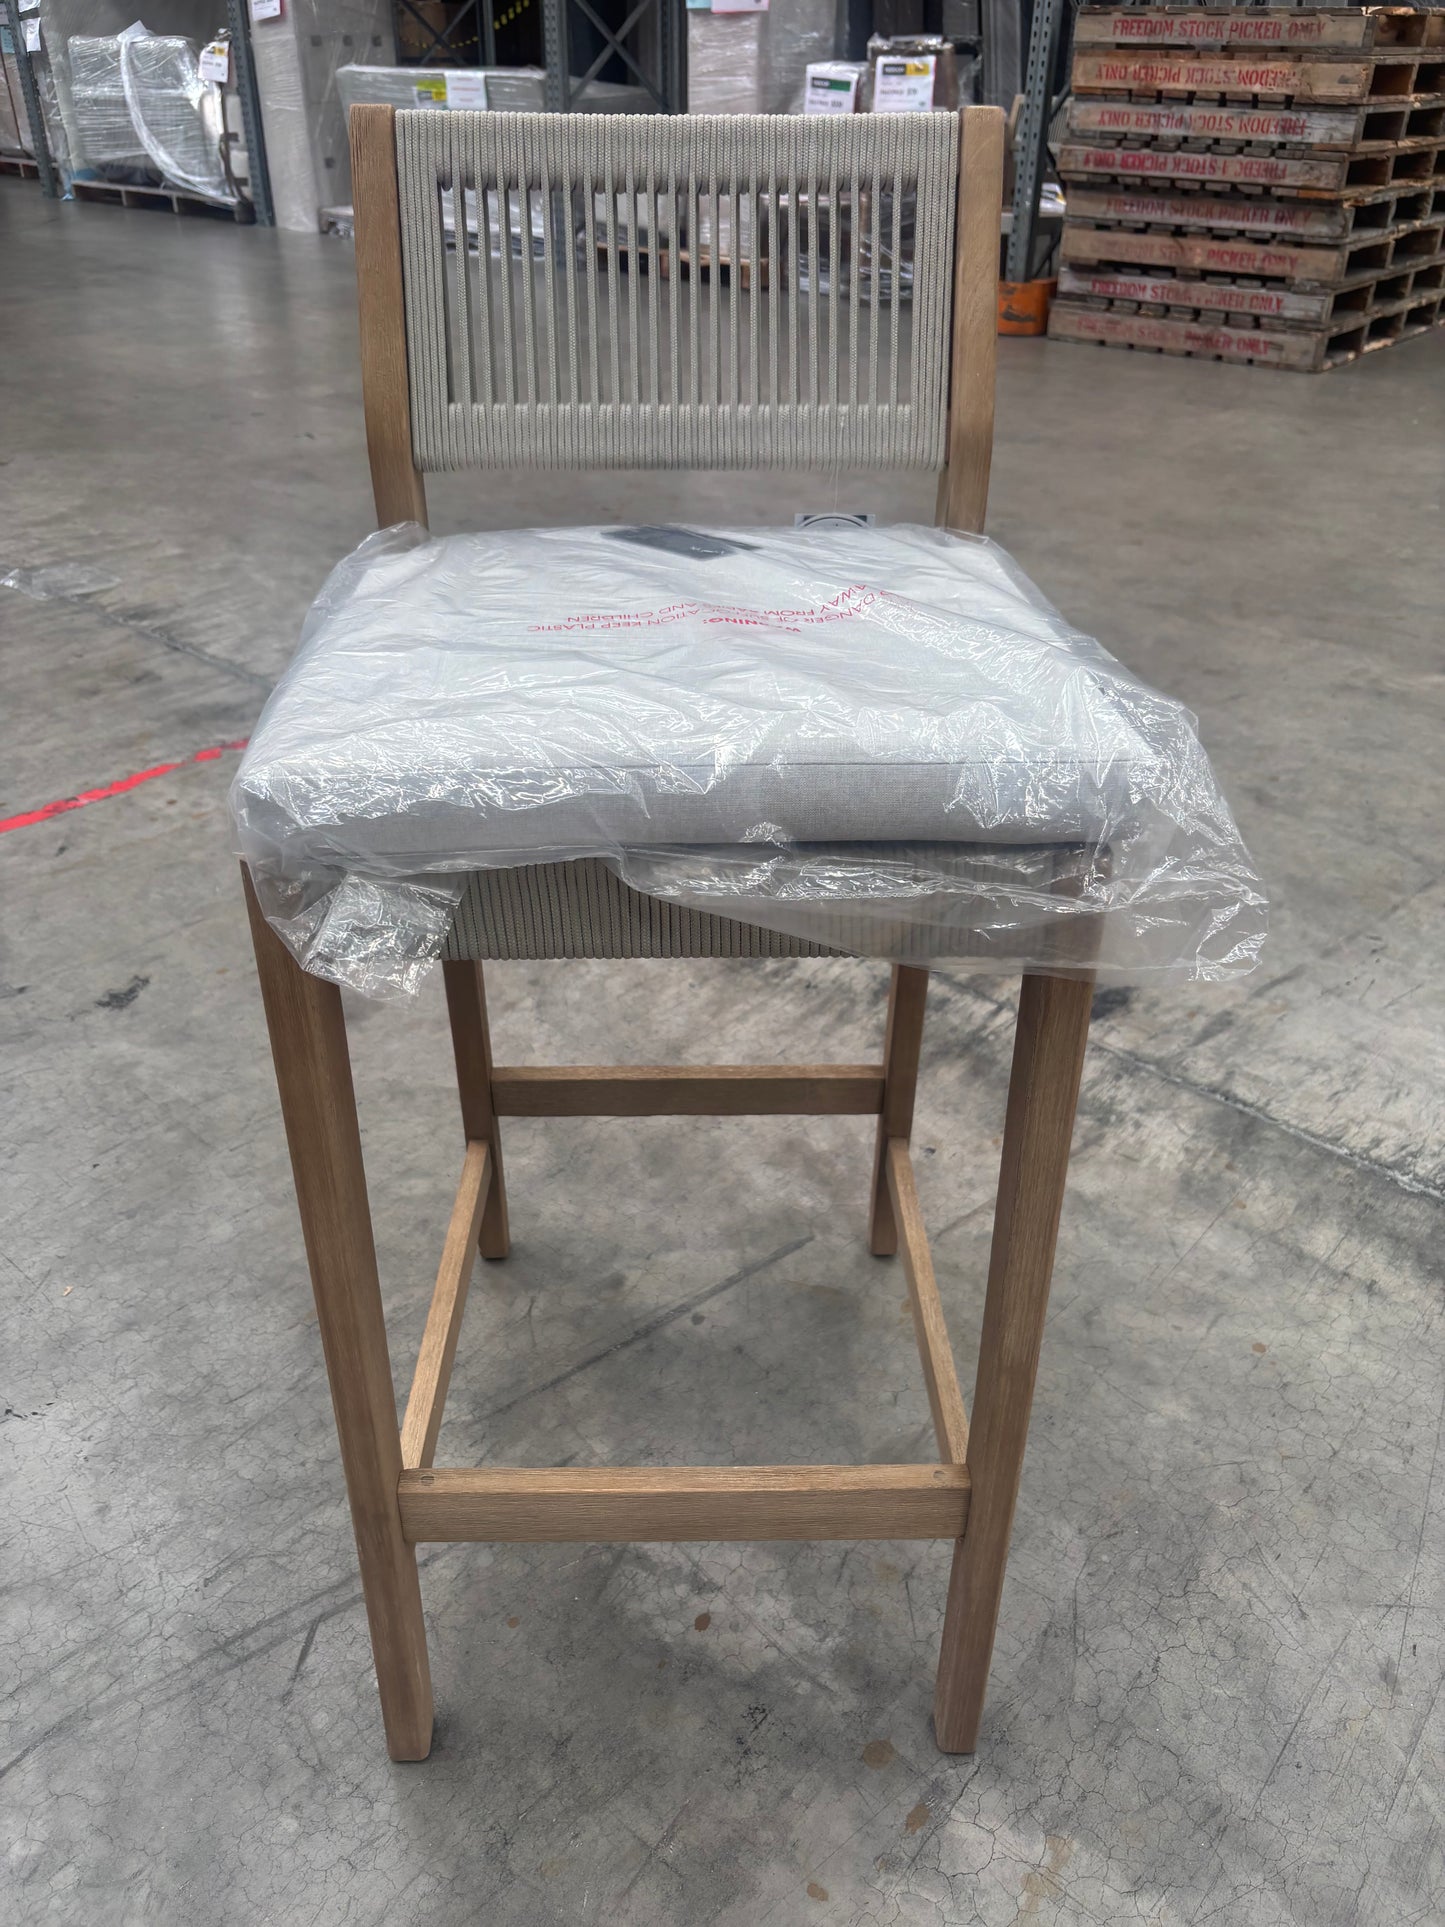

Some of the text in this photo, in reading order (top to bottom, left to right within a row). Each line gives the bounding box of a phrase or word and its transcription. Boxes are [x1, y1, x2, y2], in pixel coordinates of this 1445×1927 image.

[1112, 19, 1174, 37] FREEDOM
[1178, 20, 1225, 38] STOCK
[1229, 20, 1281, 39] PICKER
[1096, 63, 1128, 81] ONLY
[1132, 65, 1181, 83] PICKER
[1097, 110, 1131, 127] ONLY
[1136, 112, 1184, 130] PICKER
[1120, 154, 1168, 175] PICKER
[1172, 157, 1218, 177] STOCK
[1206, 248, 1257, 269] PICKER
[1249, 295, 1285, 313] ONLY
[1236, 336, 1271, 355] ONLY
[819, 584, 867, 614] AWAY
[567, 612, 654, 623] CHILDREN
[659, 602, 697, 615] AND
[764, 609, 815, 617] FROM
[804, 593, 875, 624] DANGER
[527, 623, 595, 633] PLASTIC
[601, 620, 642, 629] KEEP
